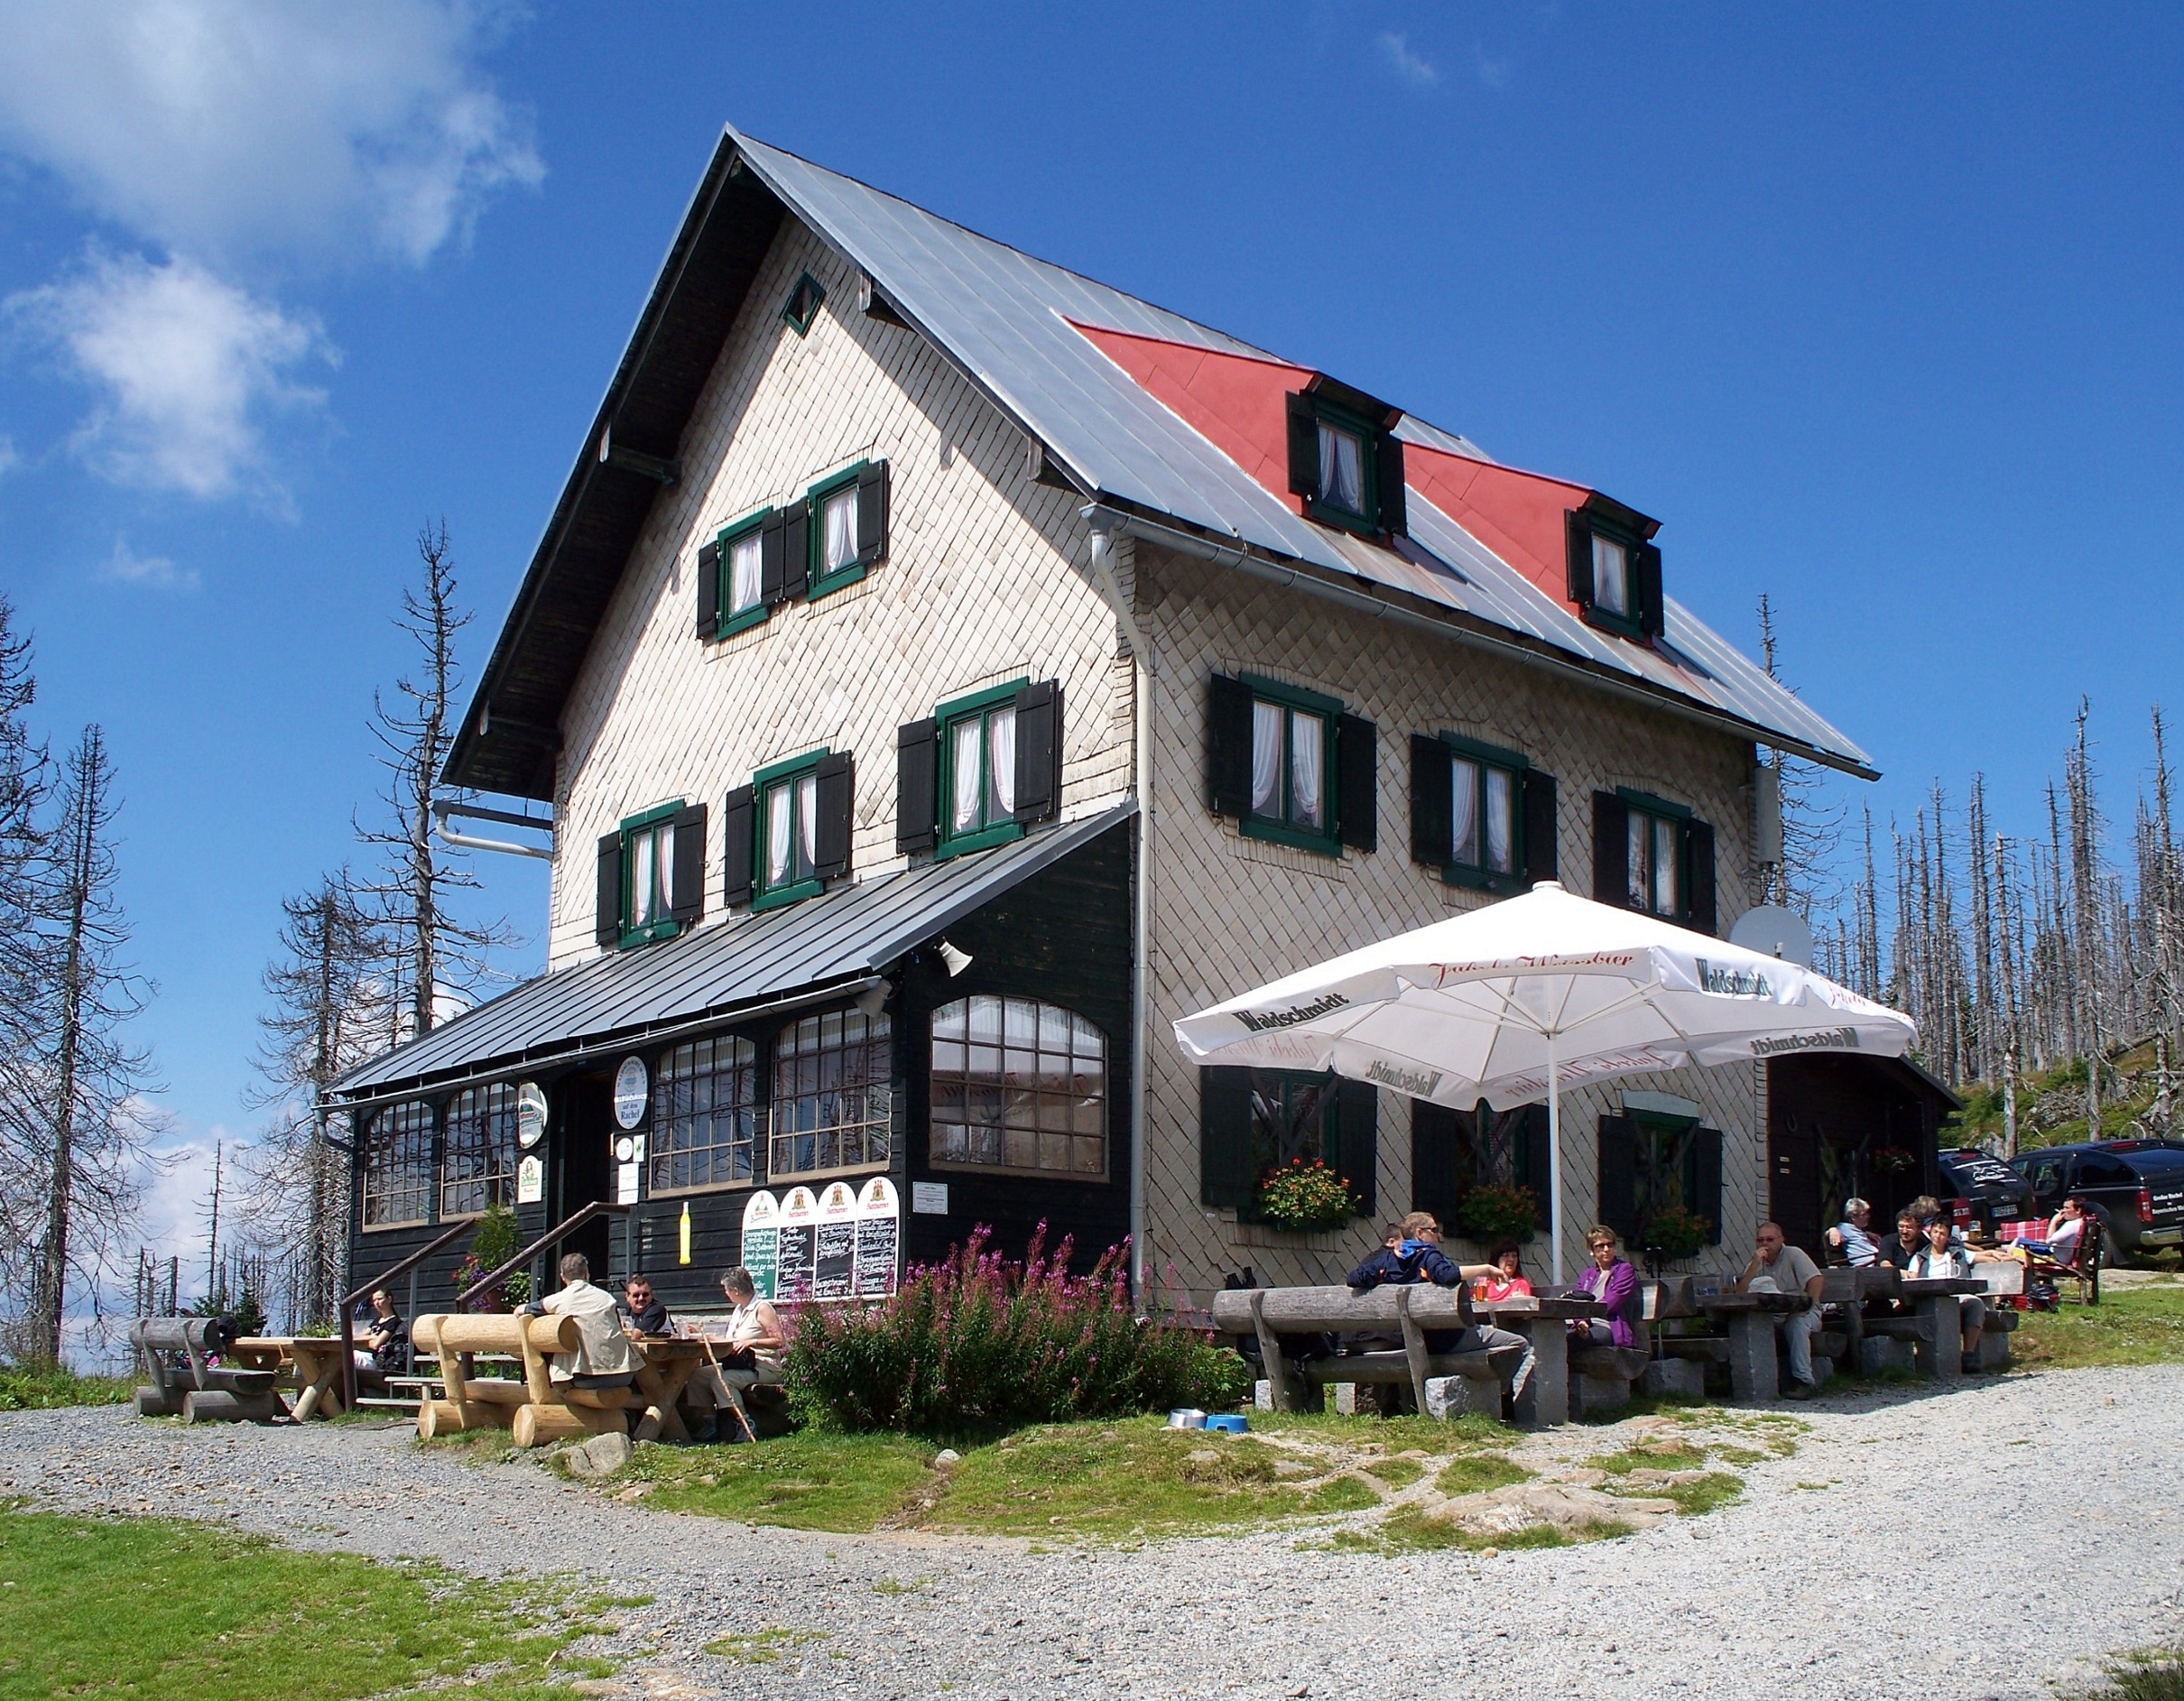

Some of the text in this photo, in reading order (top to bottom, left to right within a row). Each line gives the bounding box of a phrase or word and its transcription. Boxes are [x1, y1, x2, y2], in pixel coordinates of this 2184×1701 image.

[1694, 957, 1772, 996] Waldschmidt
[1231, 992, 1351, 1032] Waldschmidt
[621, 1109, 640, 1120] Rachel
